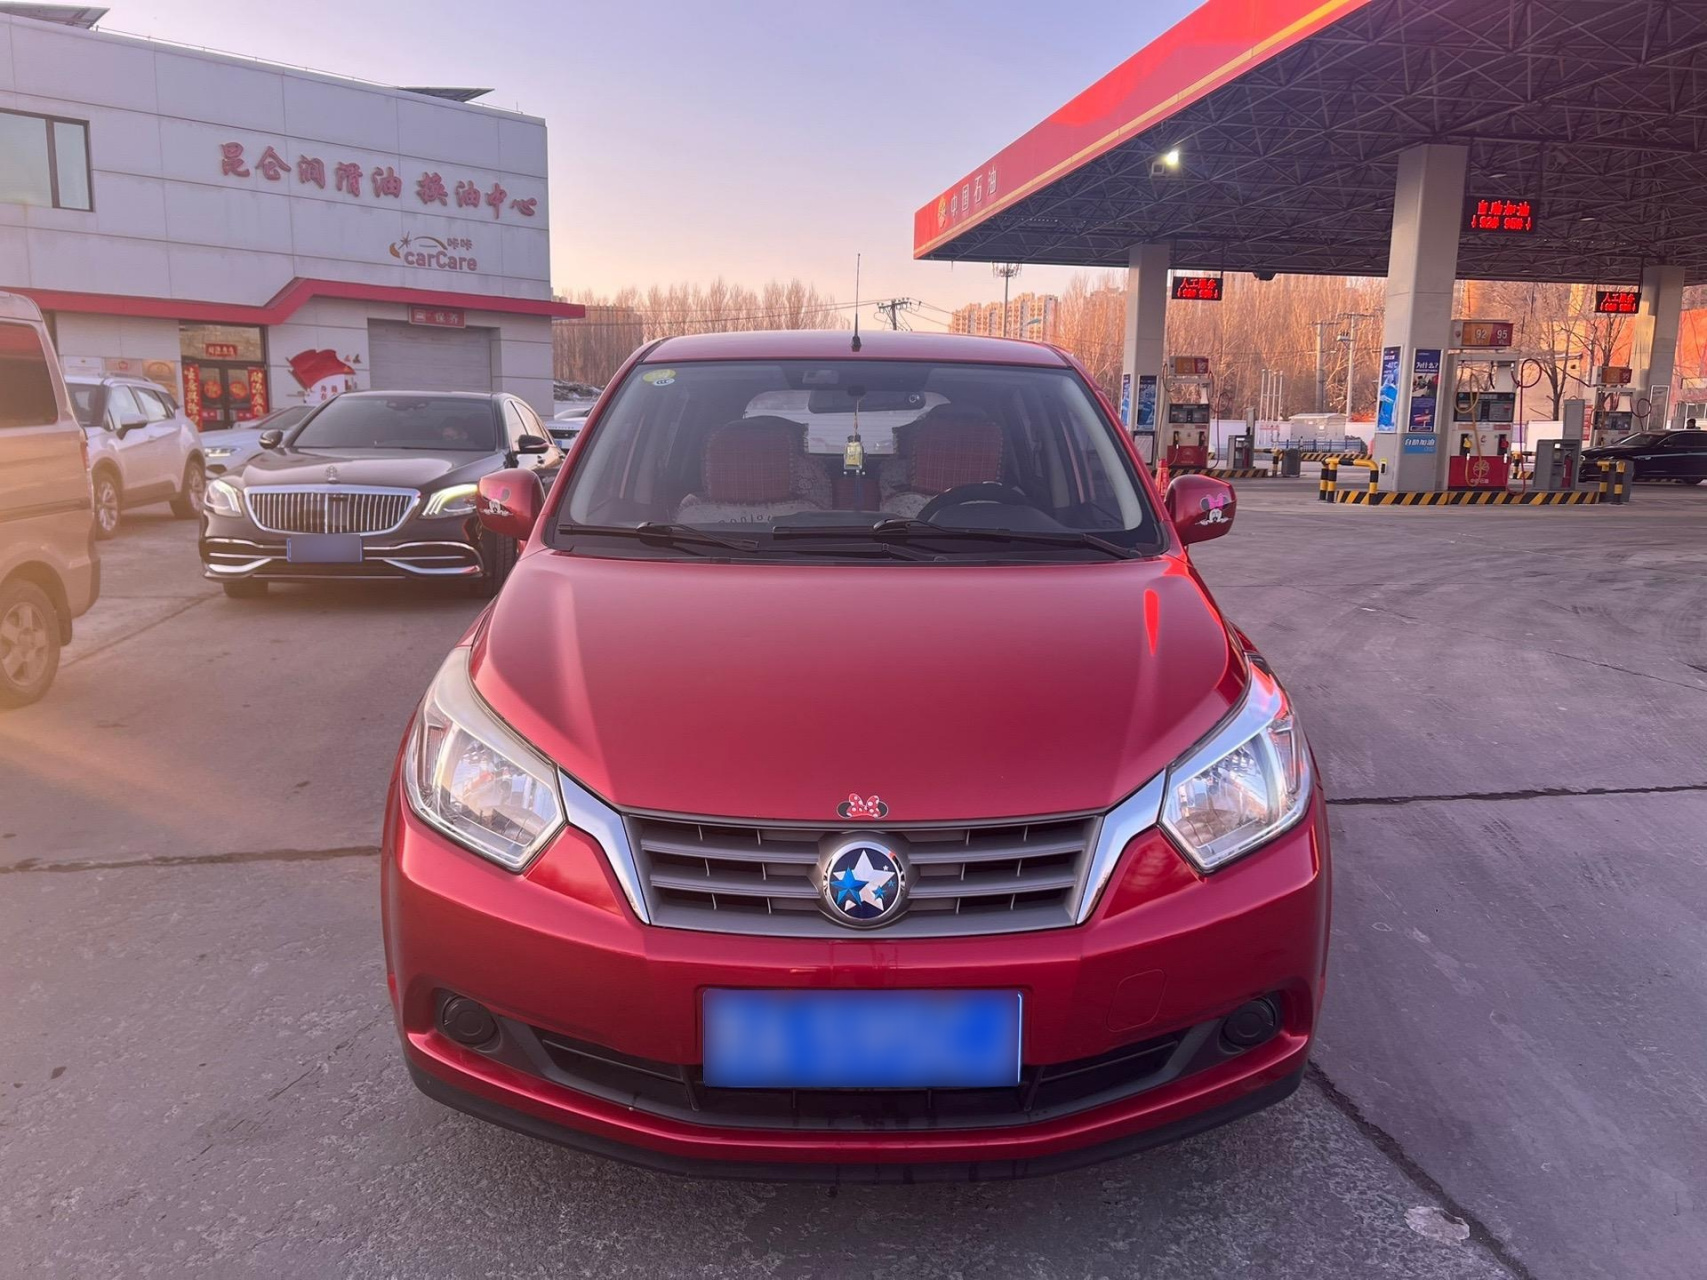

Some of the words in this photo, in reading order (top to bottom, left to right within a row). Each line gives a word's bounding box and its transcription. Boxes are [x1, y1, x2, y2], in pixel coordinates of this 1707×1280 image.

[950, 164, 997, 218] 中国石油
[404, 250, 478, 272] carCare
[1475, 328, 1487, 339] 92
[1496, 329, 1508, 340] 95
